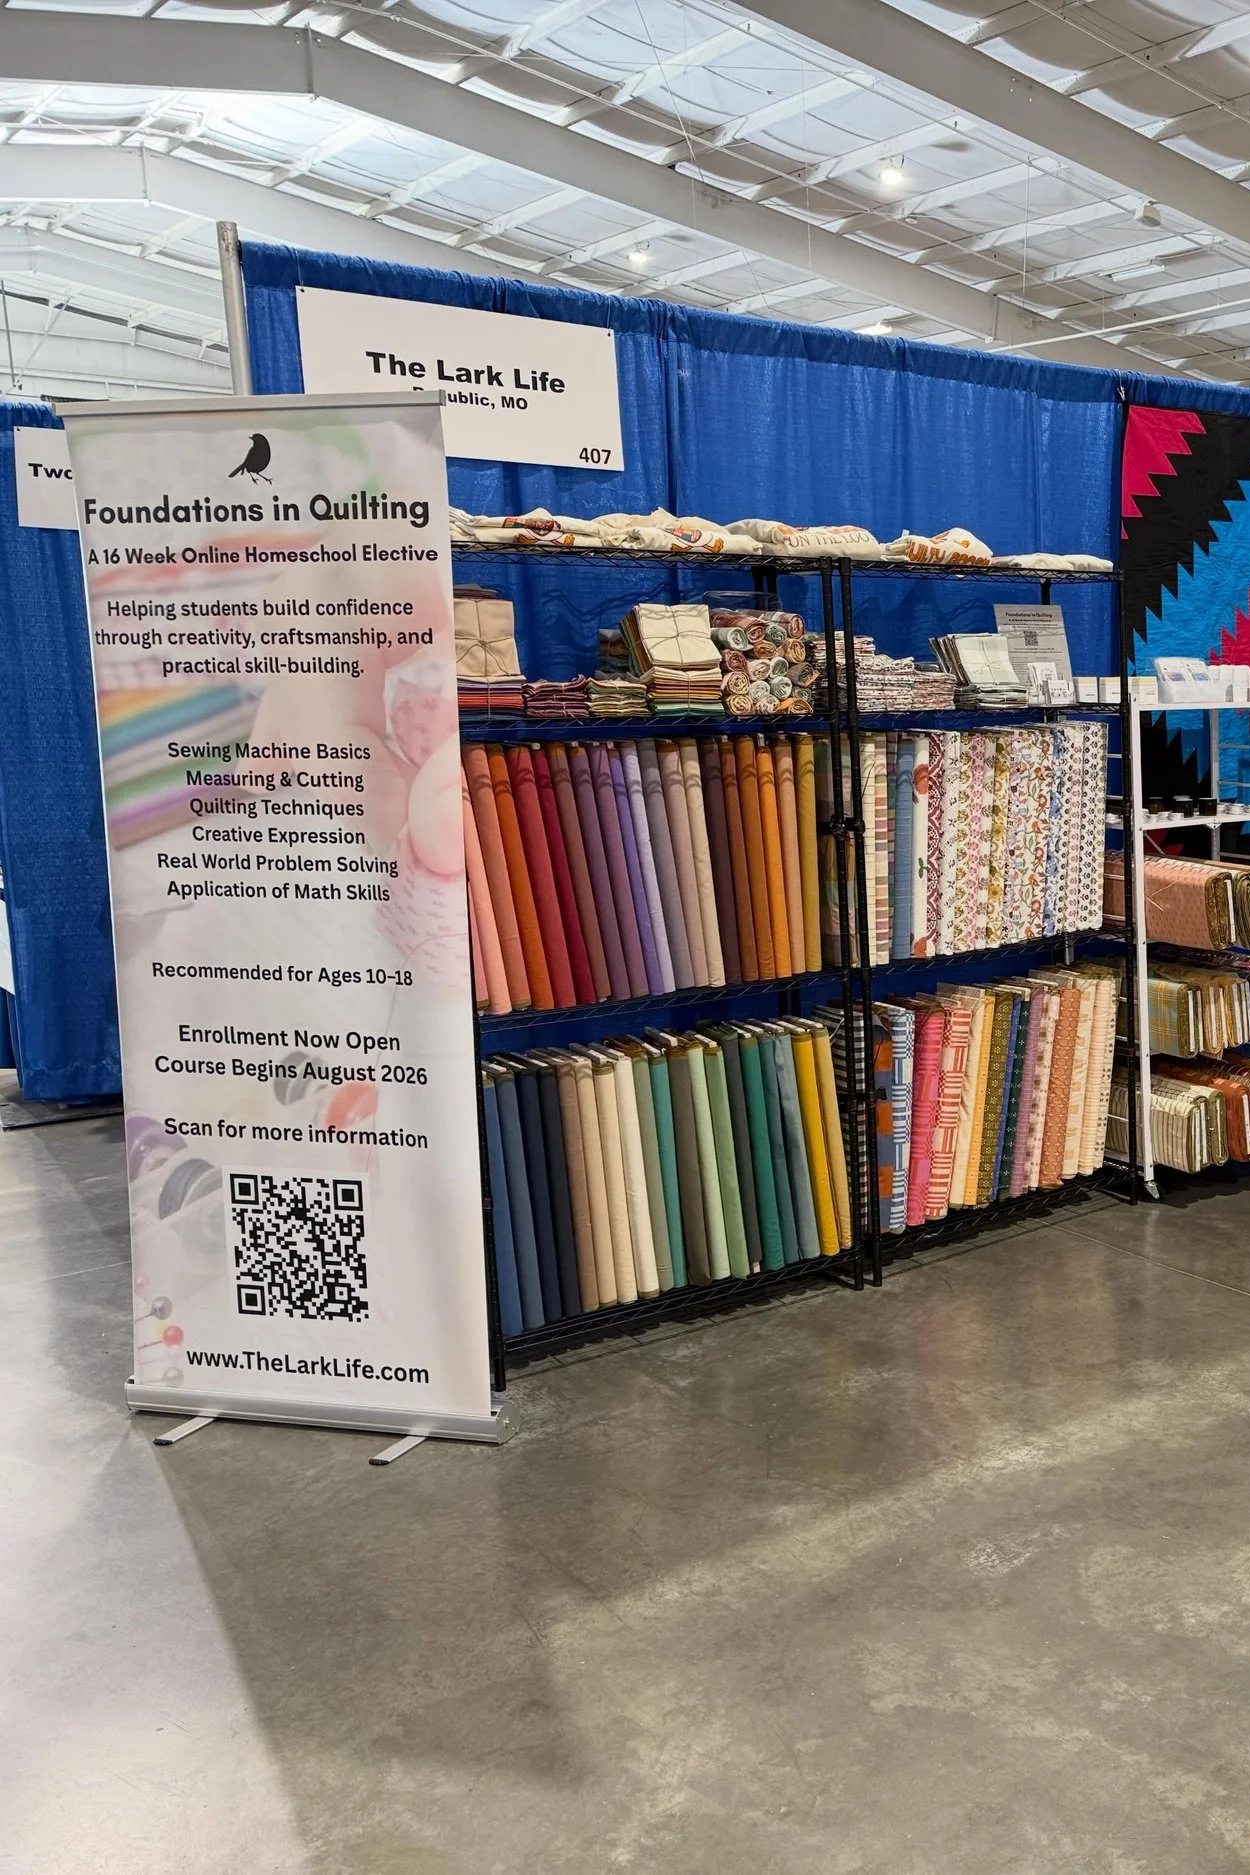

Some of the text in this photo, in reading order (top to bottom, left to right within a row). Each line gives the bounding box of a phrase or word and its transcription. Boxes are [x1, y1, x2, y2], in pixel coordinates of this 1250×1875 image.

[366, 351, 566, 393] The Lark Life
[501, 396, 528, 411] MO
[579, 447, 612, 465] 407
[83, 490, 430, 529] Foundations in Quilting
[87, 542, 439, 565] A 16 Week Online Homeschool Elective
[789, 535, 810, 548] ON
[107, 598, 414, 622] Helping students build confidence
[94, 627, 434, 650] through creativity, craftsmanship, and
[161, 656, 365, 679] practical skill-building.
[167, 741, 371, 763] Sewing Machine Basics
[185, 769, 365, 793] Measuring & Cutting
[189, 797, 365, 821] Quilting Techniques
[192, 825, 366, 848] Creative Expression
[157, 852, 399, 879] Real World Problem Solving
[166, 879, 391, 902] Application of Math Skills
[151, 961, 283, 982] Recommended
[286, 965, 314, 983] for
[317, 967, 362, 988] Ages
[178, 1024, 401, 1055] Enrollment Now Open
[154, 1055, 428, 1086] Course Begins August 2026
[164, 1117, 428, 1150] Scan for more information
[185, 1350, 430, 1384] www.TheLarkLife.com
